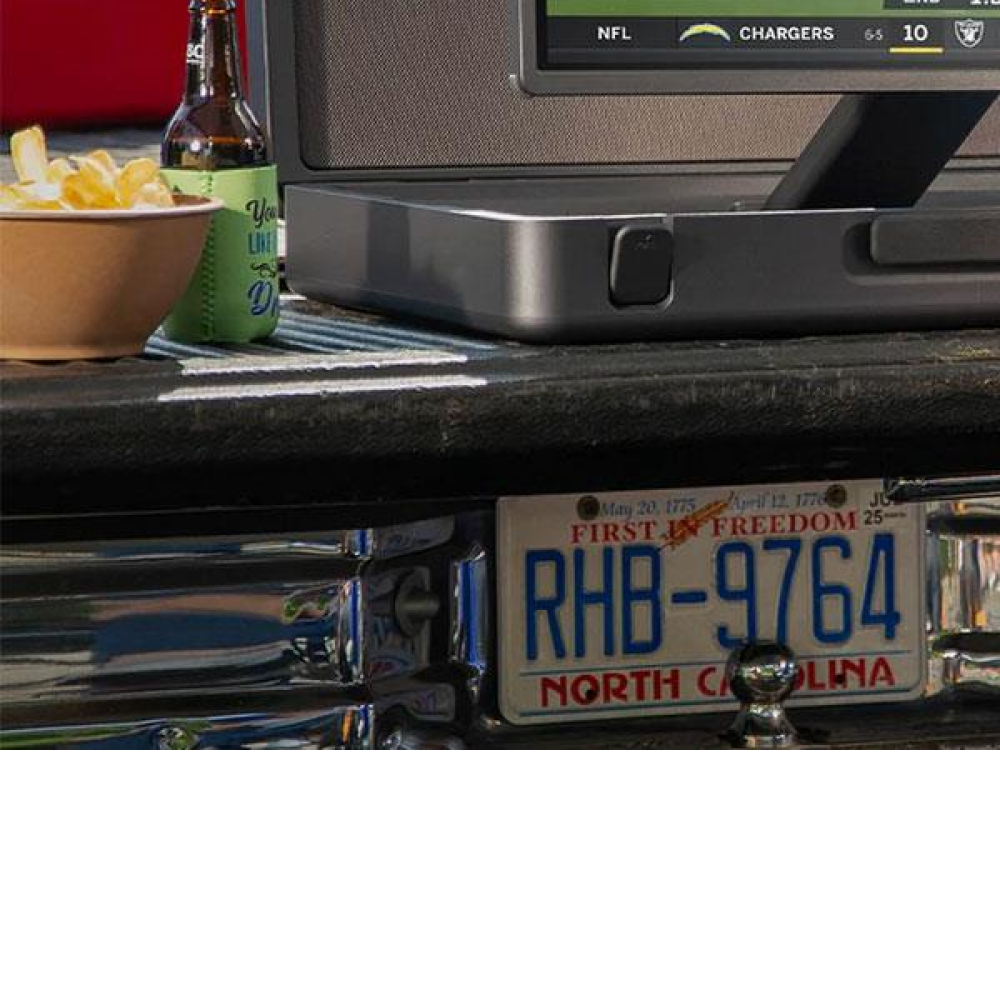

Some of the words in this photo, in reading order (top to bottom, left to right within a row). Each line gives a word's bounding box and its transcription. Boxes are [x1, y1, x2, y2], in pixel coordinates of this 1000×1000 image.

[597, 27, 631, 41] NFL
[739, 27, 834, 41] CHARGERS
[903, 24, 928, 41] 10
[570, 520, 657, 544] FIRST
[713, 509, 858, 539] FREEDOM
[863, 509, 883, 525] 25
[524, 533, 902, 661] RHB-9764
[539, 668, 681, 708] NORTH
